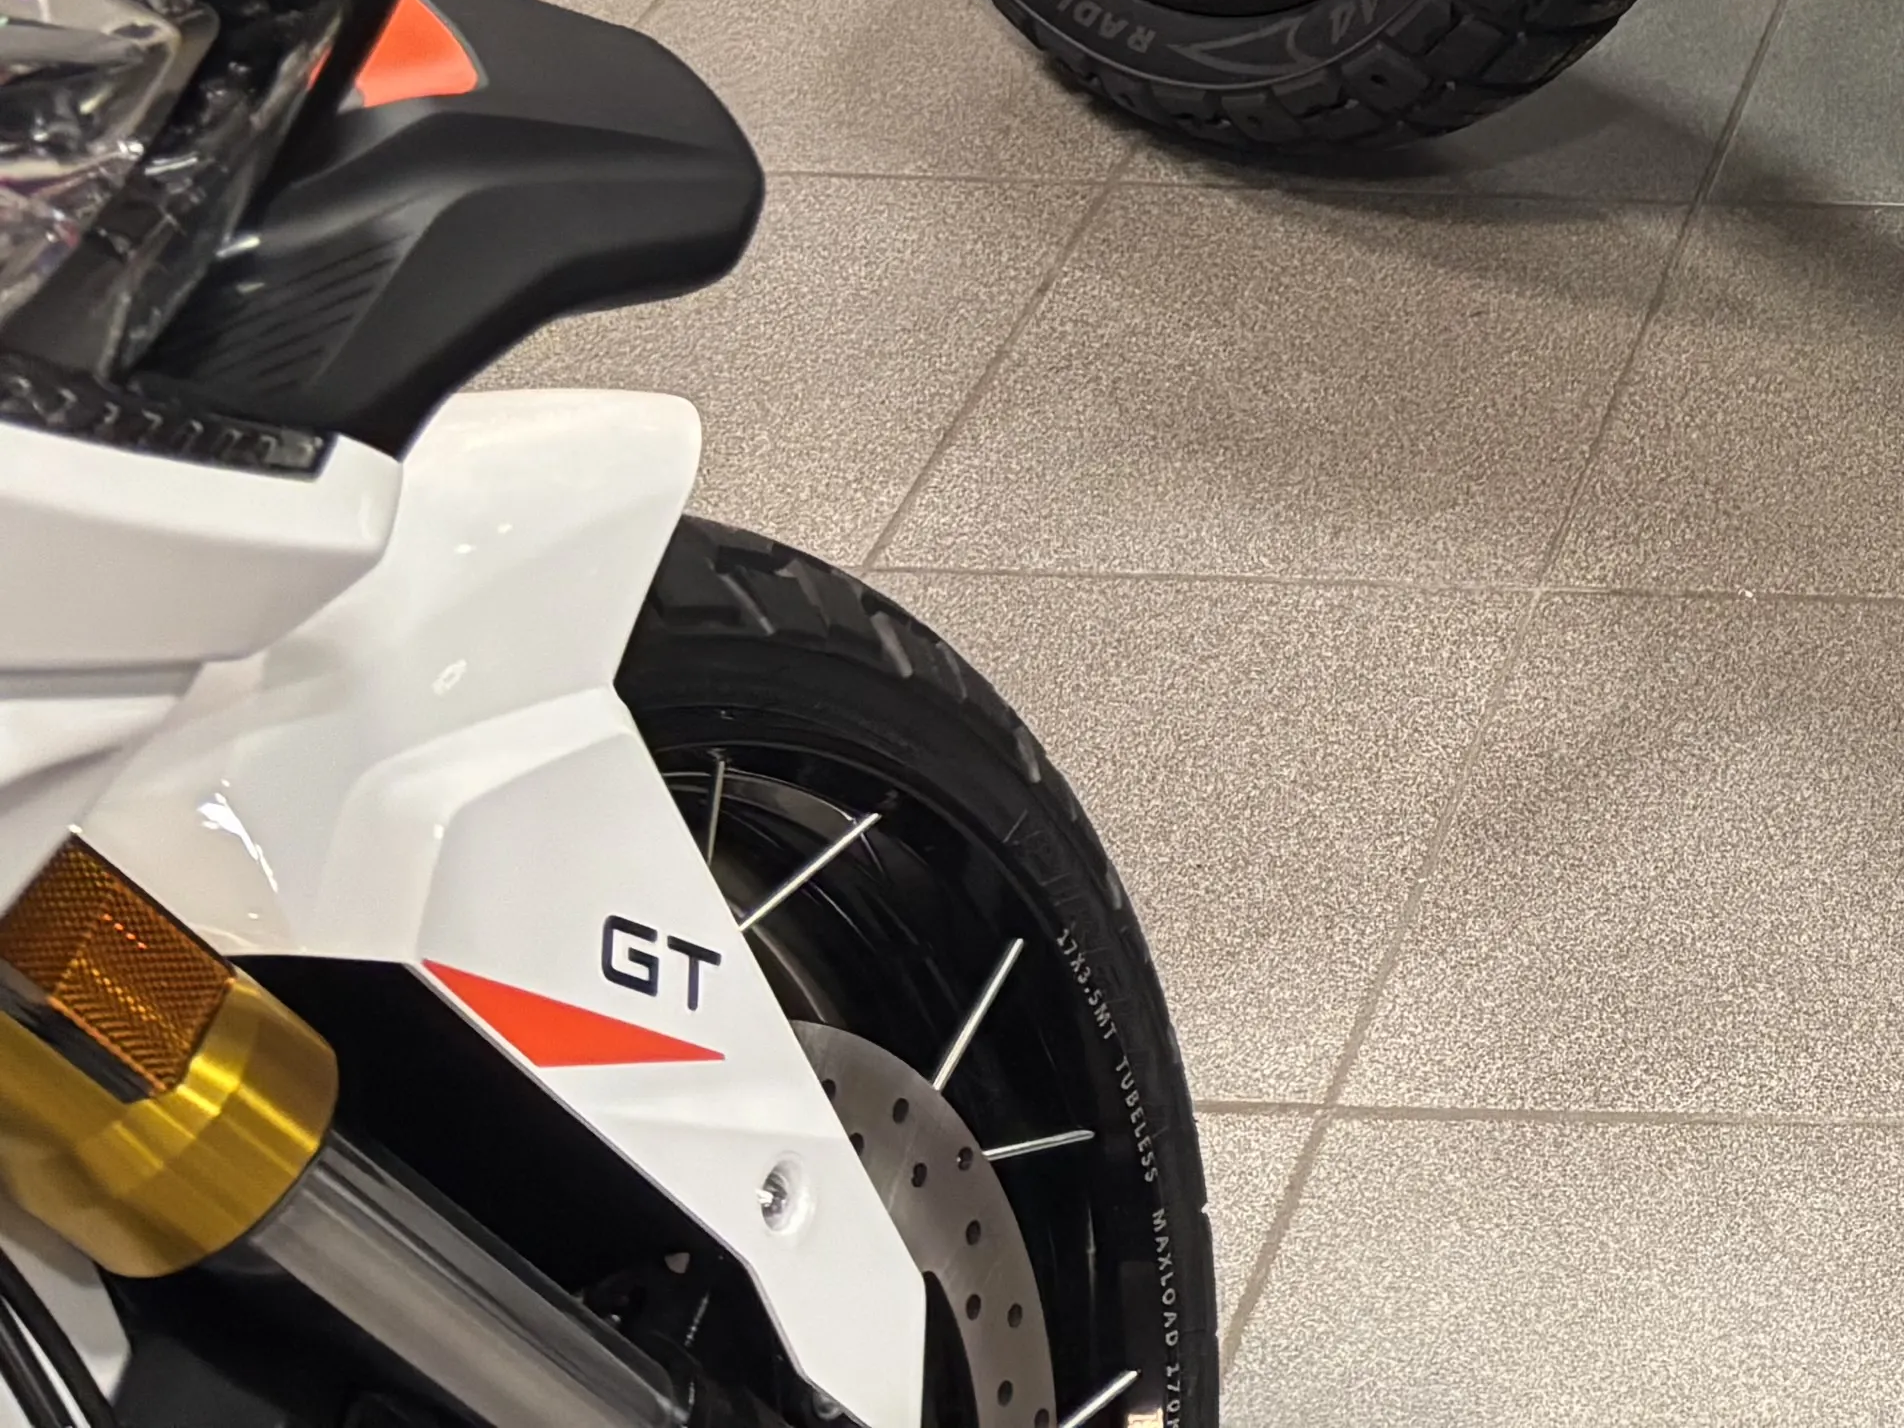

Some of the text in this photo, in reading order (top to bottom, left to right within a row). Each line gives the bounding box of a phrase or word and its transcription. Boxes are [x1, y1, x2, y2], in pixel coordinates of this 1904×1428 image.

[600, 915, 723, 1012] GT
[1056, 927, 1118, 1041] 17X3.5MT
[1113, 1055, 1160, 1184] TUBELESS
[1152, 1208, 1182, 1348] MAXLOAD
